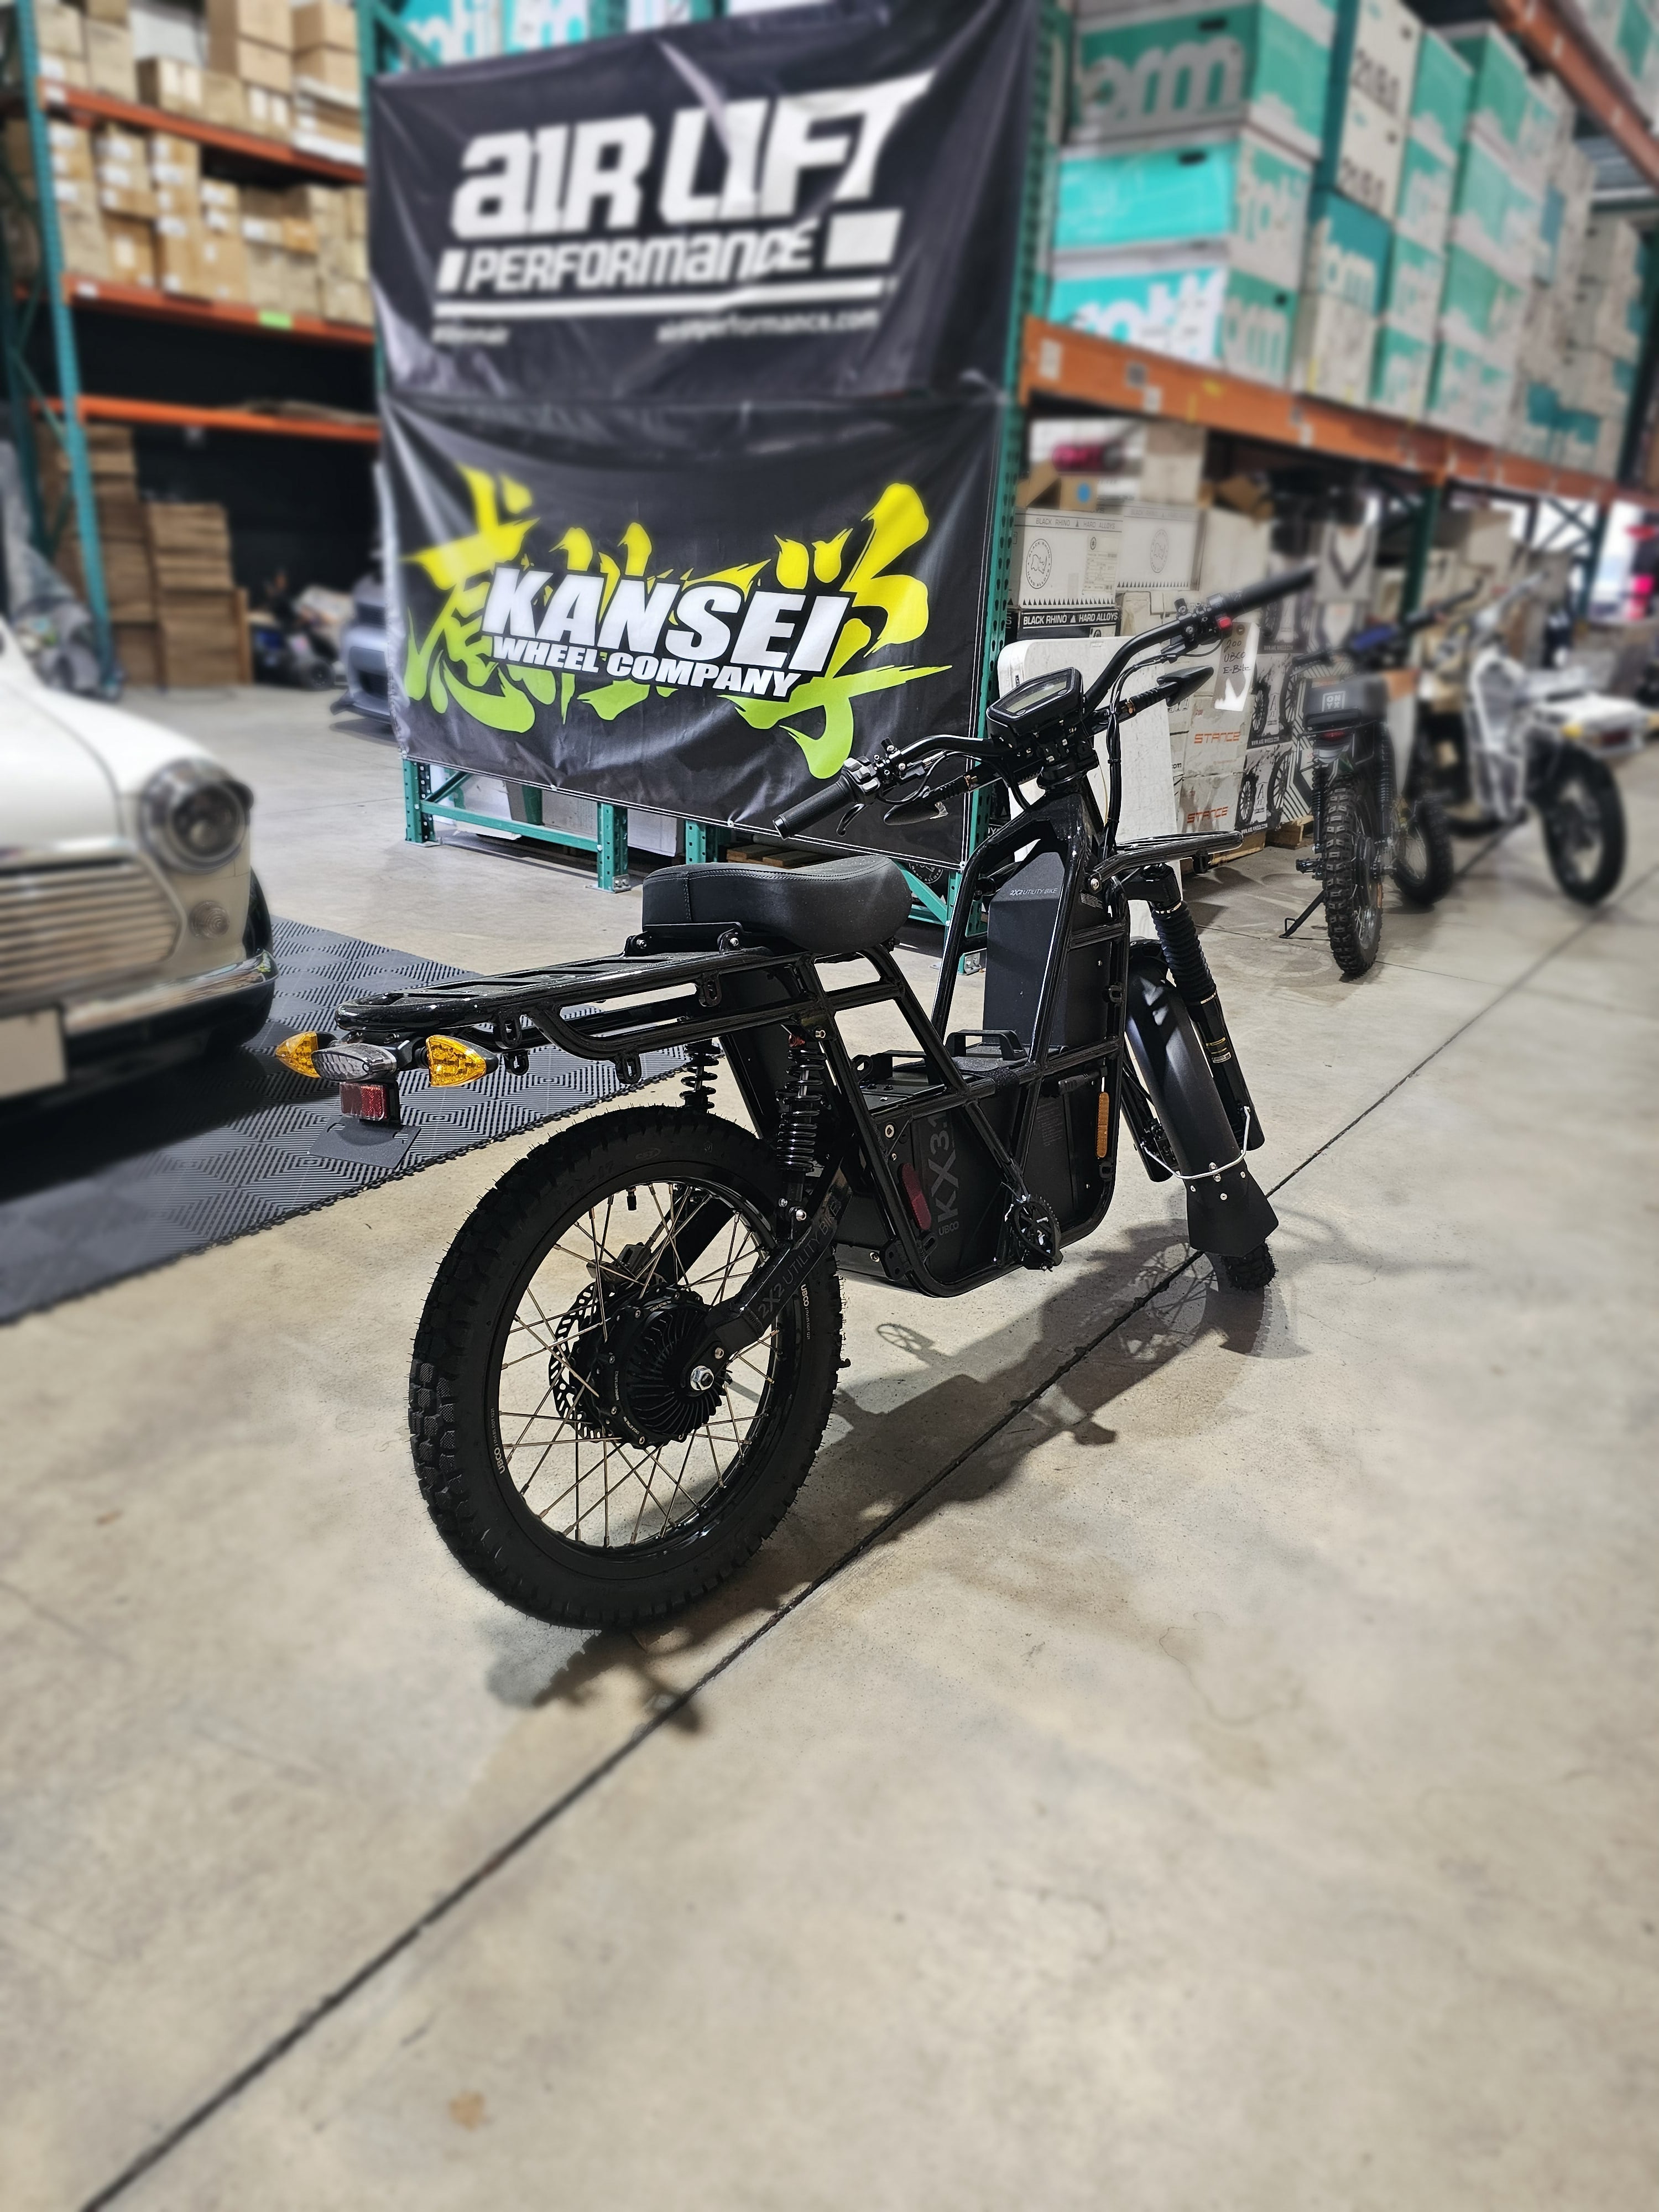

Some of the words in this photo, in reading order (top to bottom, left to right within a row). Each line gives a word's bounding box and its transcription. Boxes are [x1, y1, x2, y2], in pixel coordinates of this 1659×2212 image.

[658, 67, 937, 224] LIFT
[482, 567, 855, 672] KANSEI
[1023, 615, 1045, 625] BLACK
[1046, 614, 1067, 624] RHINO
[1079, 613, 1095, 622] HARD
[1096, 612, 1118, 622] ALLOYS
[1224, 651, 1246, 662] UBCO
[492, 635, 602, 674] WHEEL
[605, 652, 804, 698] COMPANY
[1326, 694, 1341, 702] ON
[1327, 701, 1340, 709] YX
[1194, 731, 1240, 744] STANCE
[1187, 806, 1229, 824] STANCE
[938, 1220, 959, 1236] UBCO
[758, 1282, 785, 1319] 2X2
[782, 1233, 821, 1285] UTILITY
[818, 1199, 842, 1236] BIKE
[801, 1284, 810, 1307] UBCO
[494, 1447, 505, 1474] UBCO
